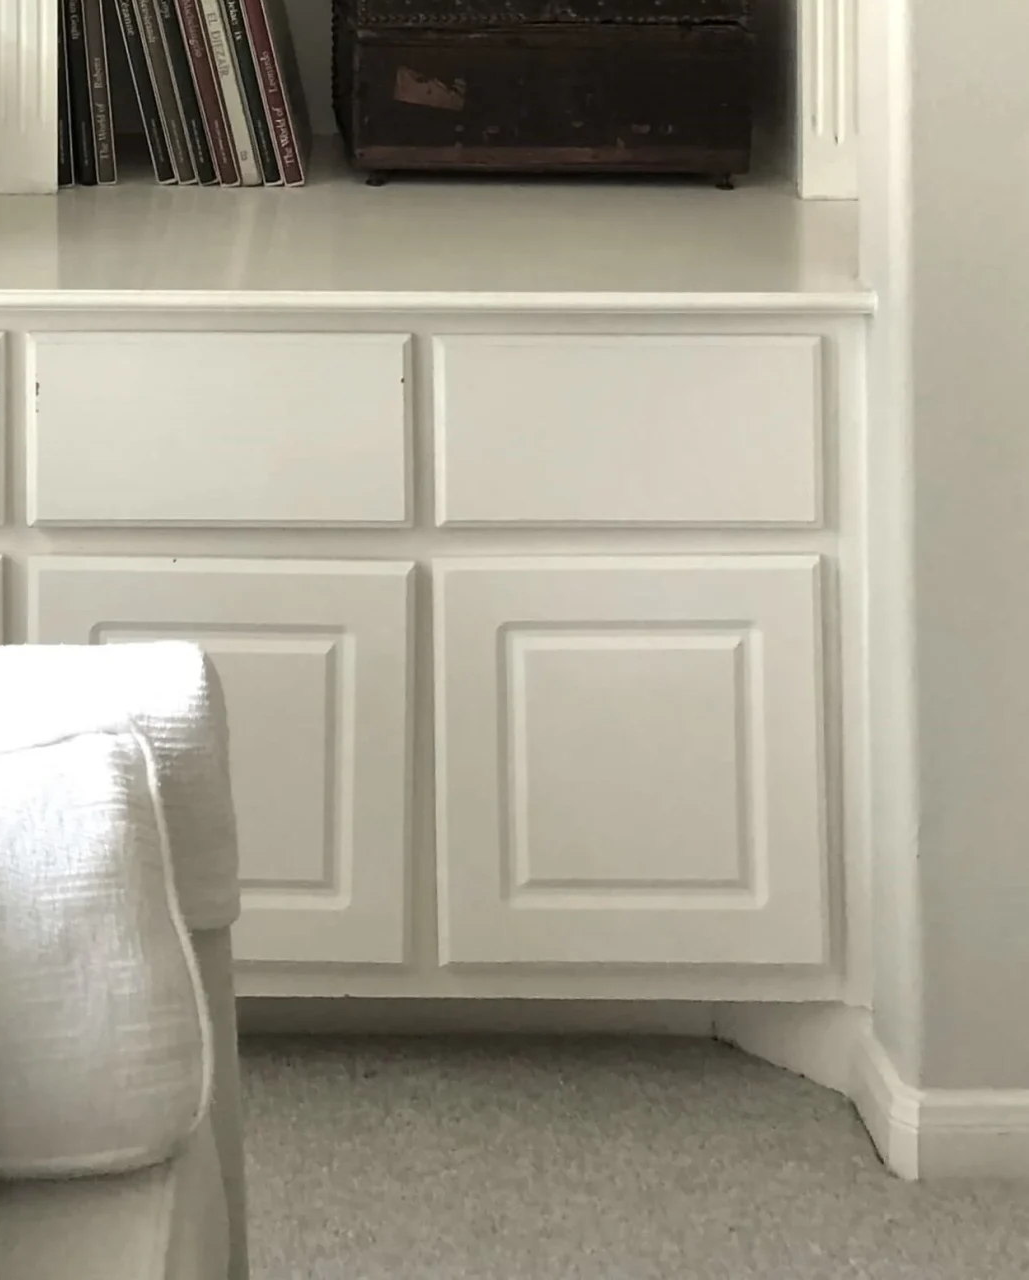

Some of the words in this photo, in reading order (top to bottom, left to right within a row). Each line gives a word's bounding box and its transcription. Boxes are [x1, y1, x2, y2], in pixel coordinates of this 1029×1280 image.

[70, 14, 81, 41] Gogh
[206, 12, 217, 26] EL
[93, 56, 105, 90] Rubens
[258, 50, 279, 95] Leonardo
[96, 102, 107, 113] of
[270, 106, 285, 118] of
[98, 113, 109, 141] World
[274, 118, 291, 148] World
[99, 140, 109, 160] The
[282, 147, 296, 168] The
